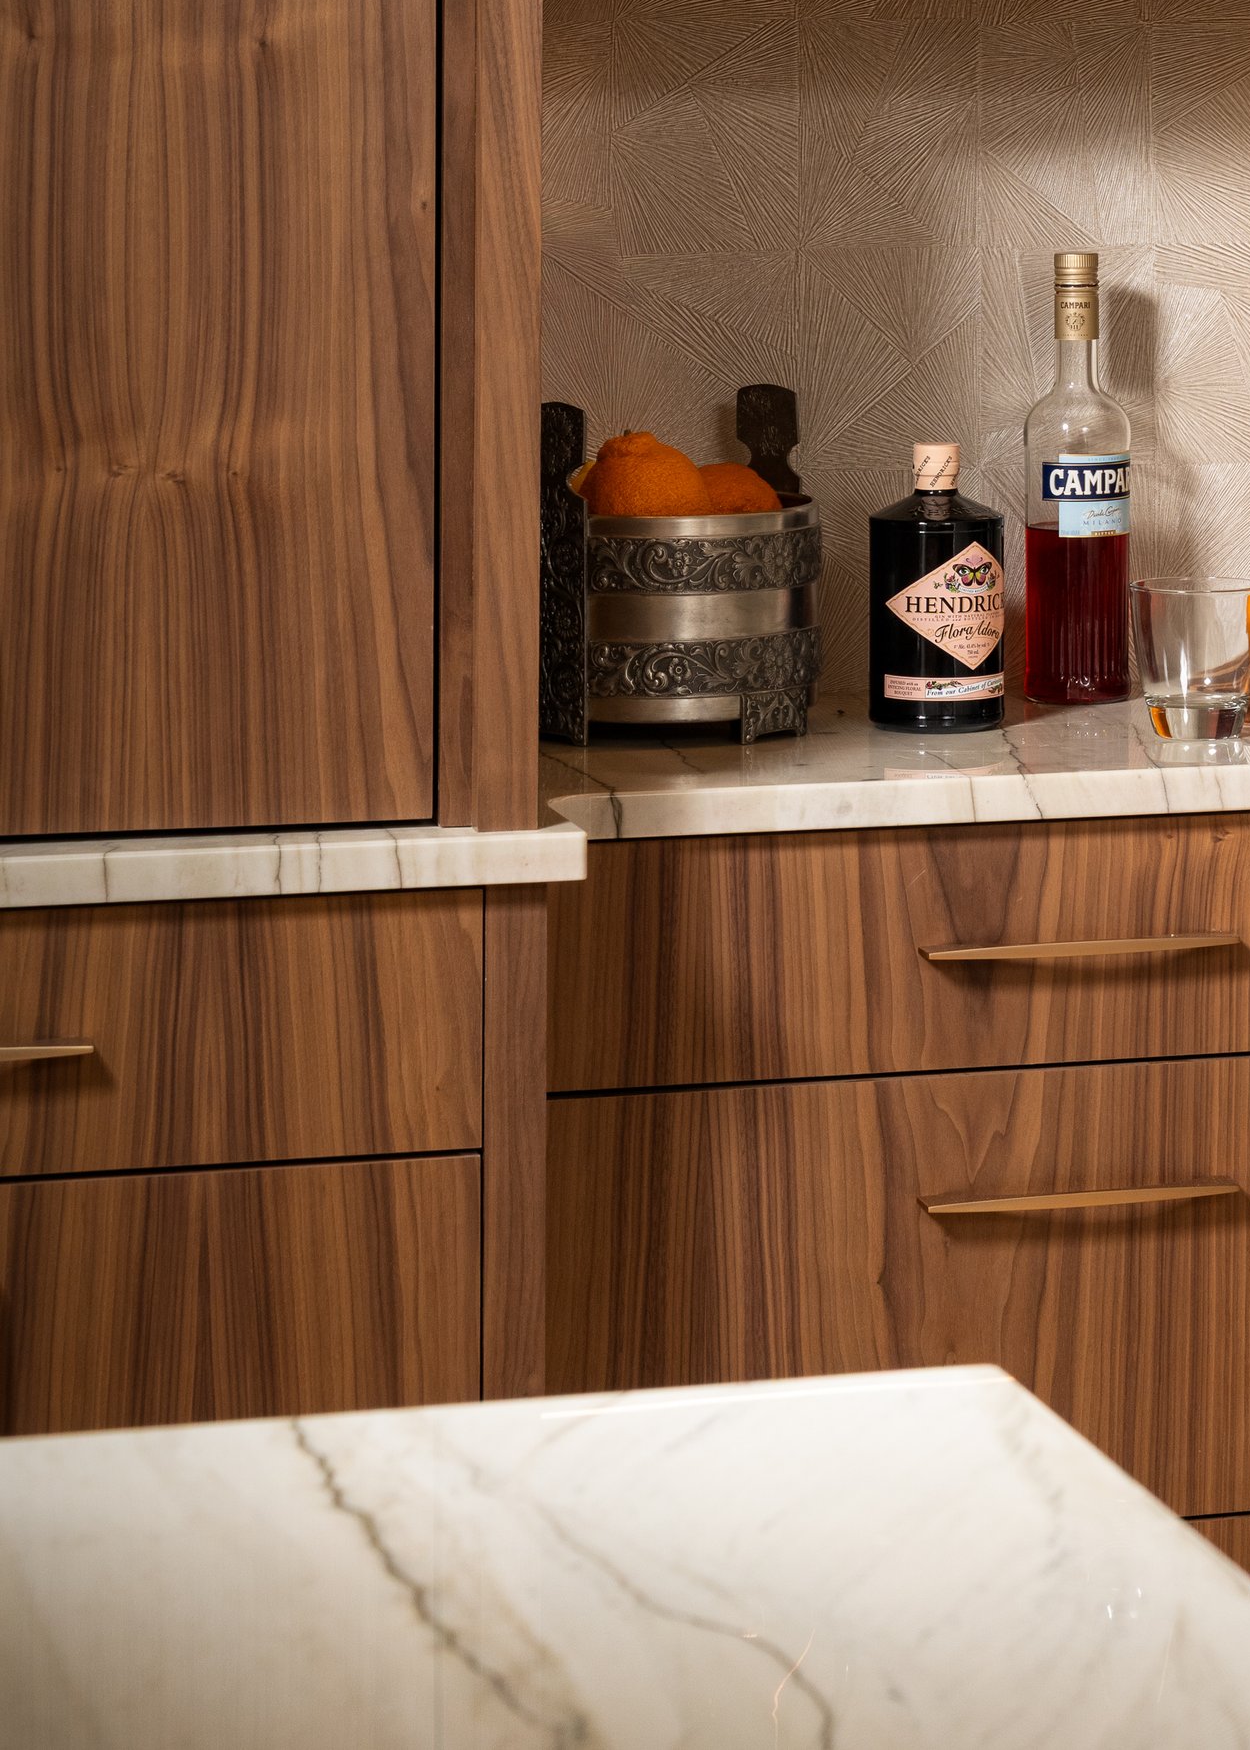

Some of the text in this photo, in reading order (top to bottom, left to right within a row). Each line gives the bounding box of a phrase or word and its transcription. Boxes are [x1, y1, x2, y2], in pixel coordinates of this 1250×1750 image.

[1060, 301, 1091, 309] CAMPARI
[935, 624, 974, 643] Flora
[958, 684, 980, 693] Cabinet
